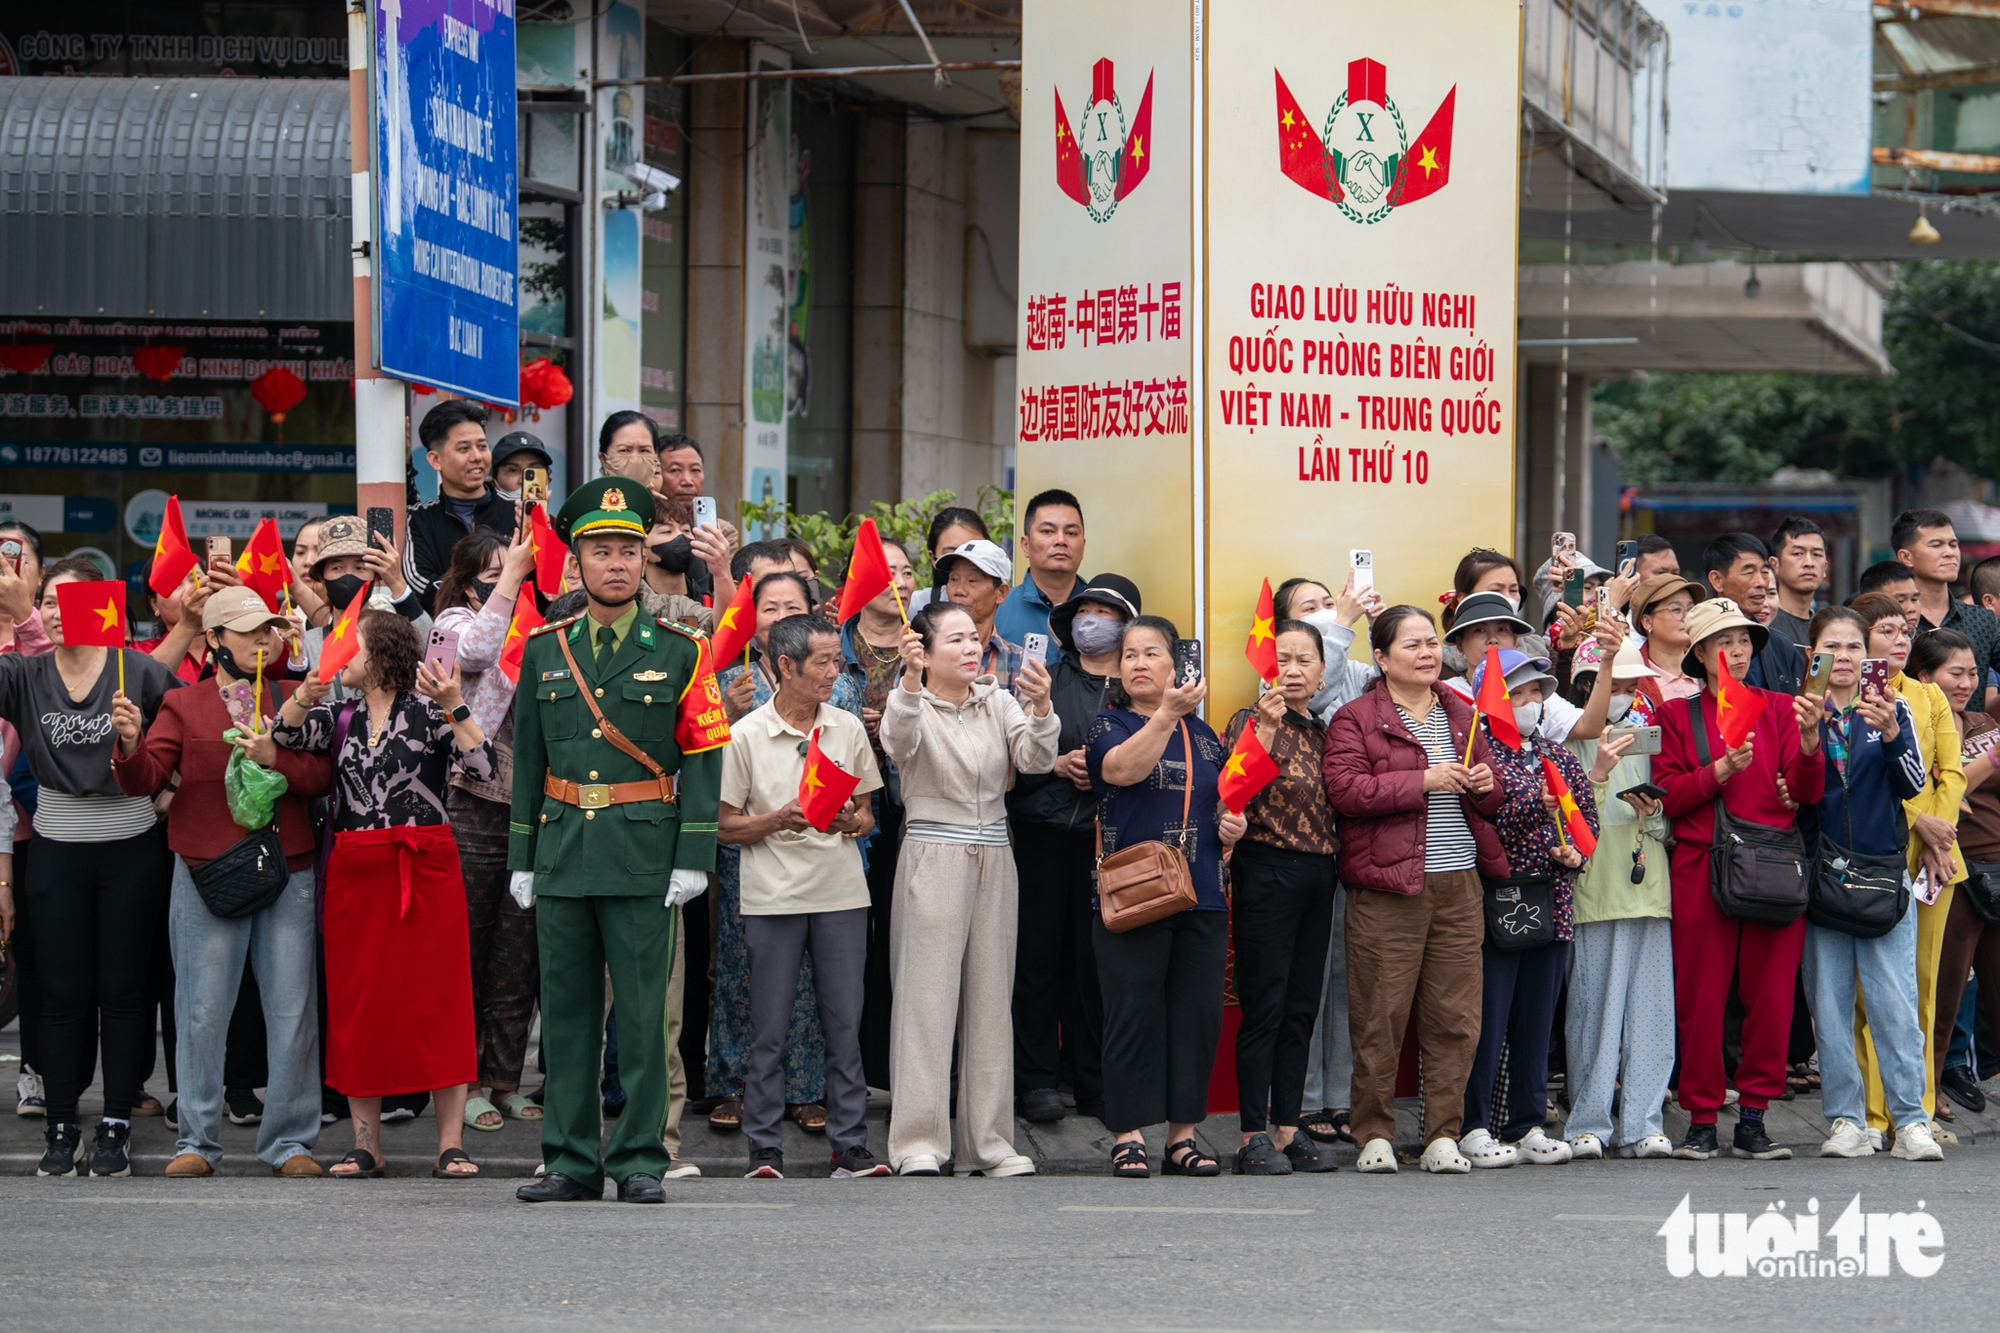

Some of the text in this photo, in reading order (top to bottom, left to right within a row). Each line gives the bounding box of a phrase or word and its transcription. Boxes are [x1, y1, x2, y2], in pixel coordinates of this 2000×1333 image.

[18, 30, 85, 60] CÔNG
[90, 34, 123, 60] TY
[129, 35, 194, 61] TNHH
[198, 35, 255, 67] DỊCH
[256, 36, 291, 68] VỤ
[1356, 112, 1375, 142] X
[1250, 282, 1475, 337] GIAO LƯU HỮU NGHỊ
[53, 352, 91, 377] CÁC
[199, 358, 243, 380] KINH
[1229, 325, 1494, 382] QUỐC PHÒNG BIÊN GIỚI
[1019, 375, 1188, 443] 边境国防友好交流
[1220, 382, 1501, 437] VIỆT NAM - TRUNG QUỐC
[24, 447, 128, 465] 18776122485
[1299, 434, 1429, 485] LẦN THỨ 10
[696, 706, 722, 727] KIỂM
